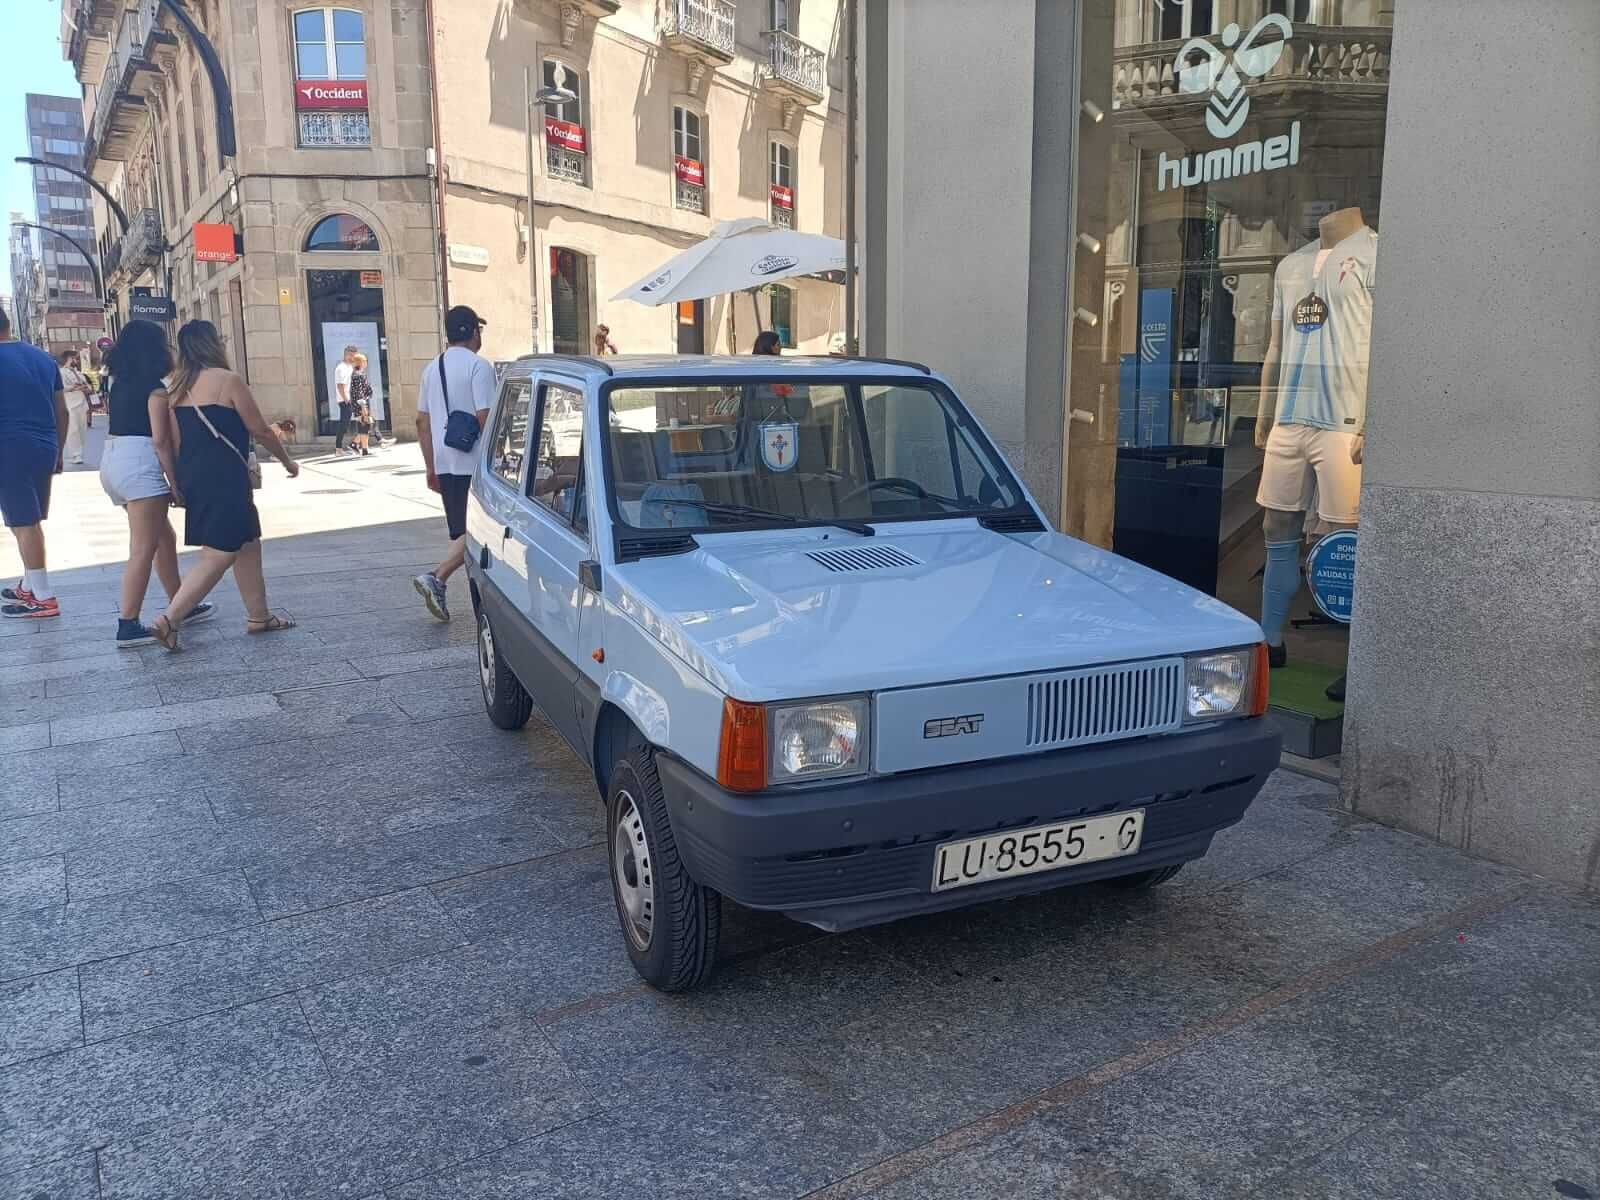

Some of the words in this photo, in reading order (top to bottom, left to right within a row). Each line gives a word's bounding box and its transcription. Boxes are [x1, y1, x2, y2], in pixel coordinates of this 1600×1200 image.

[314, 87, 363, 99] Occident
[1158, 120, 1300, 192] hummel
[133, 304, 167, 314] flormar
[924, 713, 984, 739] SEAT
